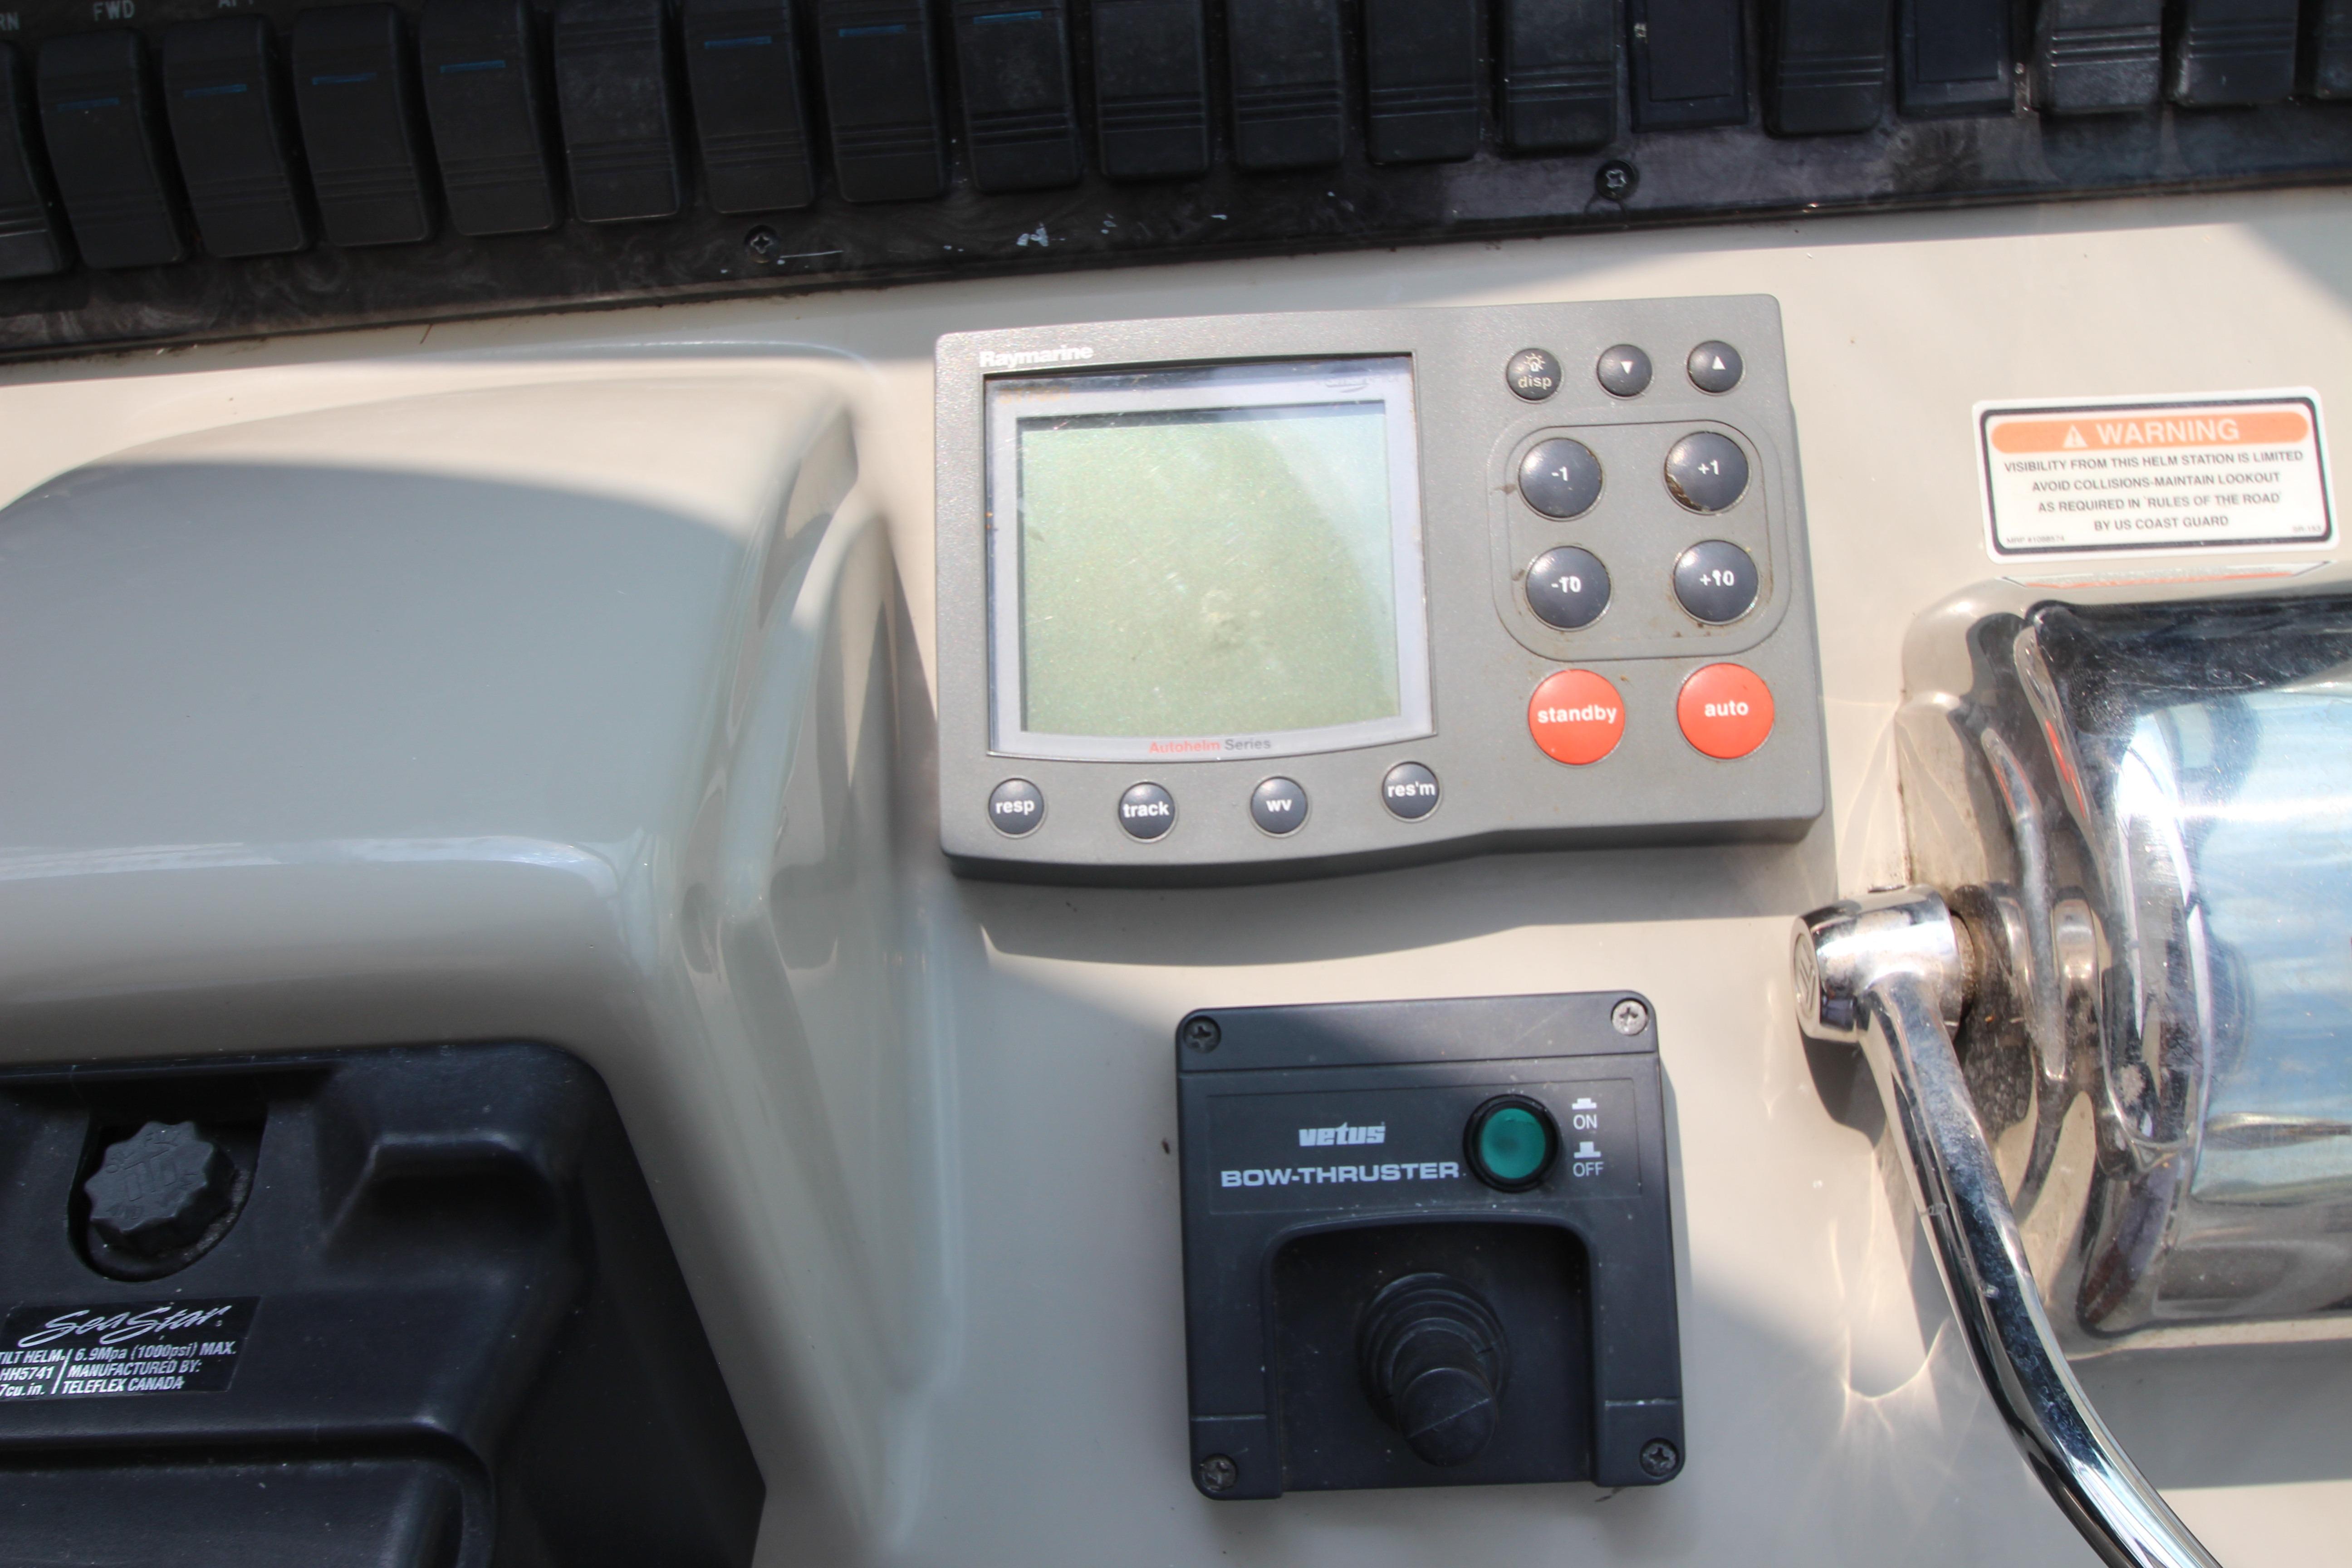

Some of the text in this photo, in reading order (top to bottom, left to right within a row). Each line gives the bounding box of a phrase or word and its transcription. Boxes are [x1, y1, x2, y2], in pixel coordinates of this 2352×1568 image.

[93, 0, 135, 21] FWD
[979, 344, 1094, 368] Raymarine
[1517, 374, 1552, 390] disp
[2095, 418, 2240, 446] WARNING
[1697, 460, 1720, 475] +1
[2004, 450, 2303, 473] VISIBILITY FROM THIS HELM STATION IS LIMITED
[1551, 466, 1568, 482] -1
[2032, 480, 2070, 493] AVOID
[2218, 472, 2281, 485] LOOKOUT
[2038, 501, 2055, 513] AS
[2059, 499, 2125, 512] REQUIRED
[2128, 498, 2140, 509] IN
[2193, 494, 2210, 506] OF
[2214, 493, 2240, 505] THE
[2094, 516, 2229, 531] BY US COAST GUARD
[1551, 575, 1582, 593] -10
[1700, 569, 1735, 587] +10
[1537, 704, 1617, 725] standby
[1704, 700, 1749, 717] auto
[1149, 738, 1271, 754] Autohelm Series
[1387, 781, 1436, 798] res'm
[995, 799, 1035, 816] resp
[1122, 801, 1170, 818] track
[1266, 799, 1293, 812] wv
[1573, 1114, 1597, 1130] ON
[1220, 1161, 1460, 1187] BOW-THRUSTER
[1573, 1161, 1604, 1177] OFF
[74, 1340, 237, 1362] 6.9Mpa (1000psi) MAX.
[66, 1358, 203, 1378] MANUFACTURED BY:
[61, 1376, 184, 1395] TELEFLEX CANADA
